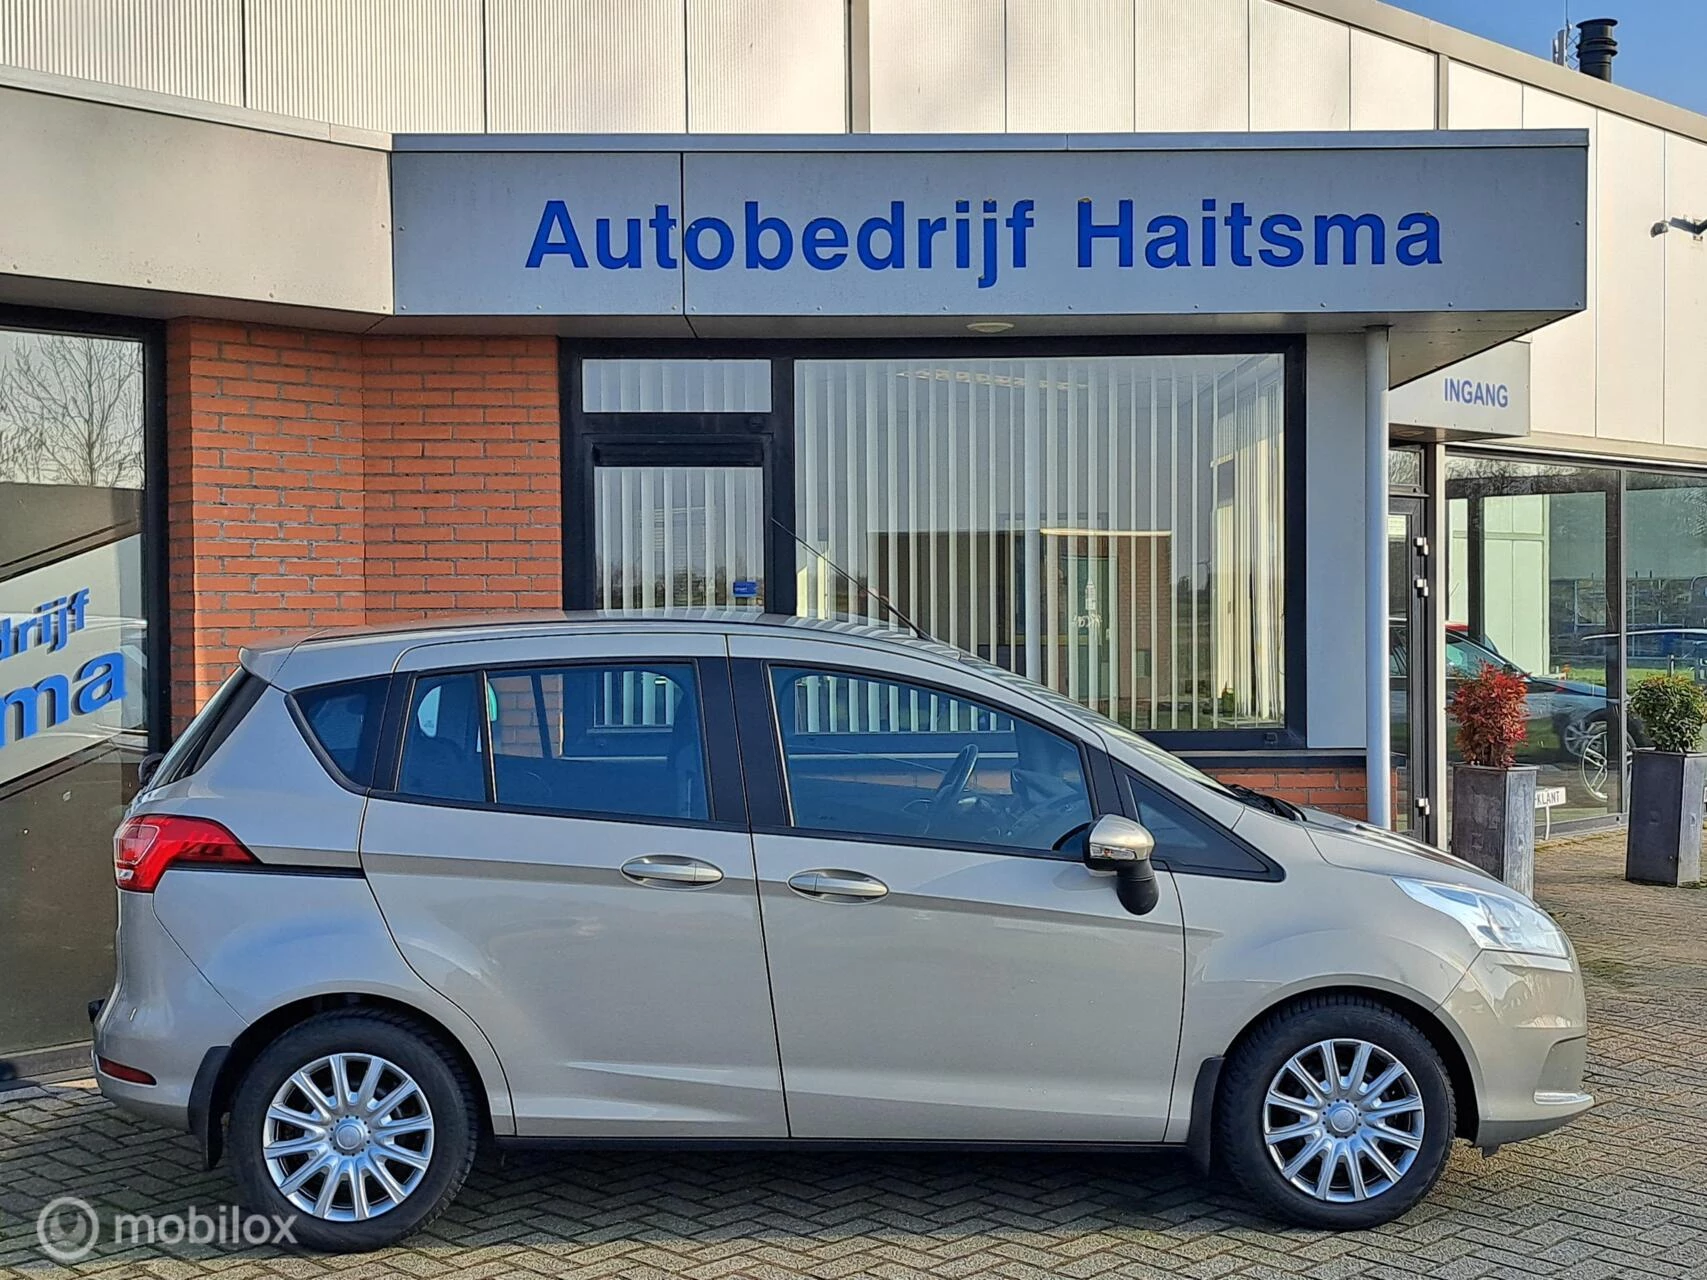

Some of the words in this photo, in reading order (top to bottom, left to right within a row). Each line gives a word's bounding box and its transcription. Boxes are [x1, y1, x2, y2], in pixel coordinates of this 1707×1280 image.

[525, 198, 1035, 288] Autobedrijf
[1077, 198, 1443, 269] Haitsma
[1444, 378, 1508, 408] INGANG
